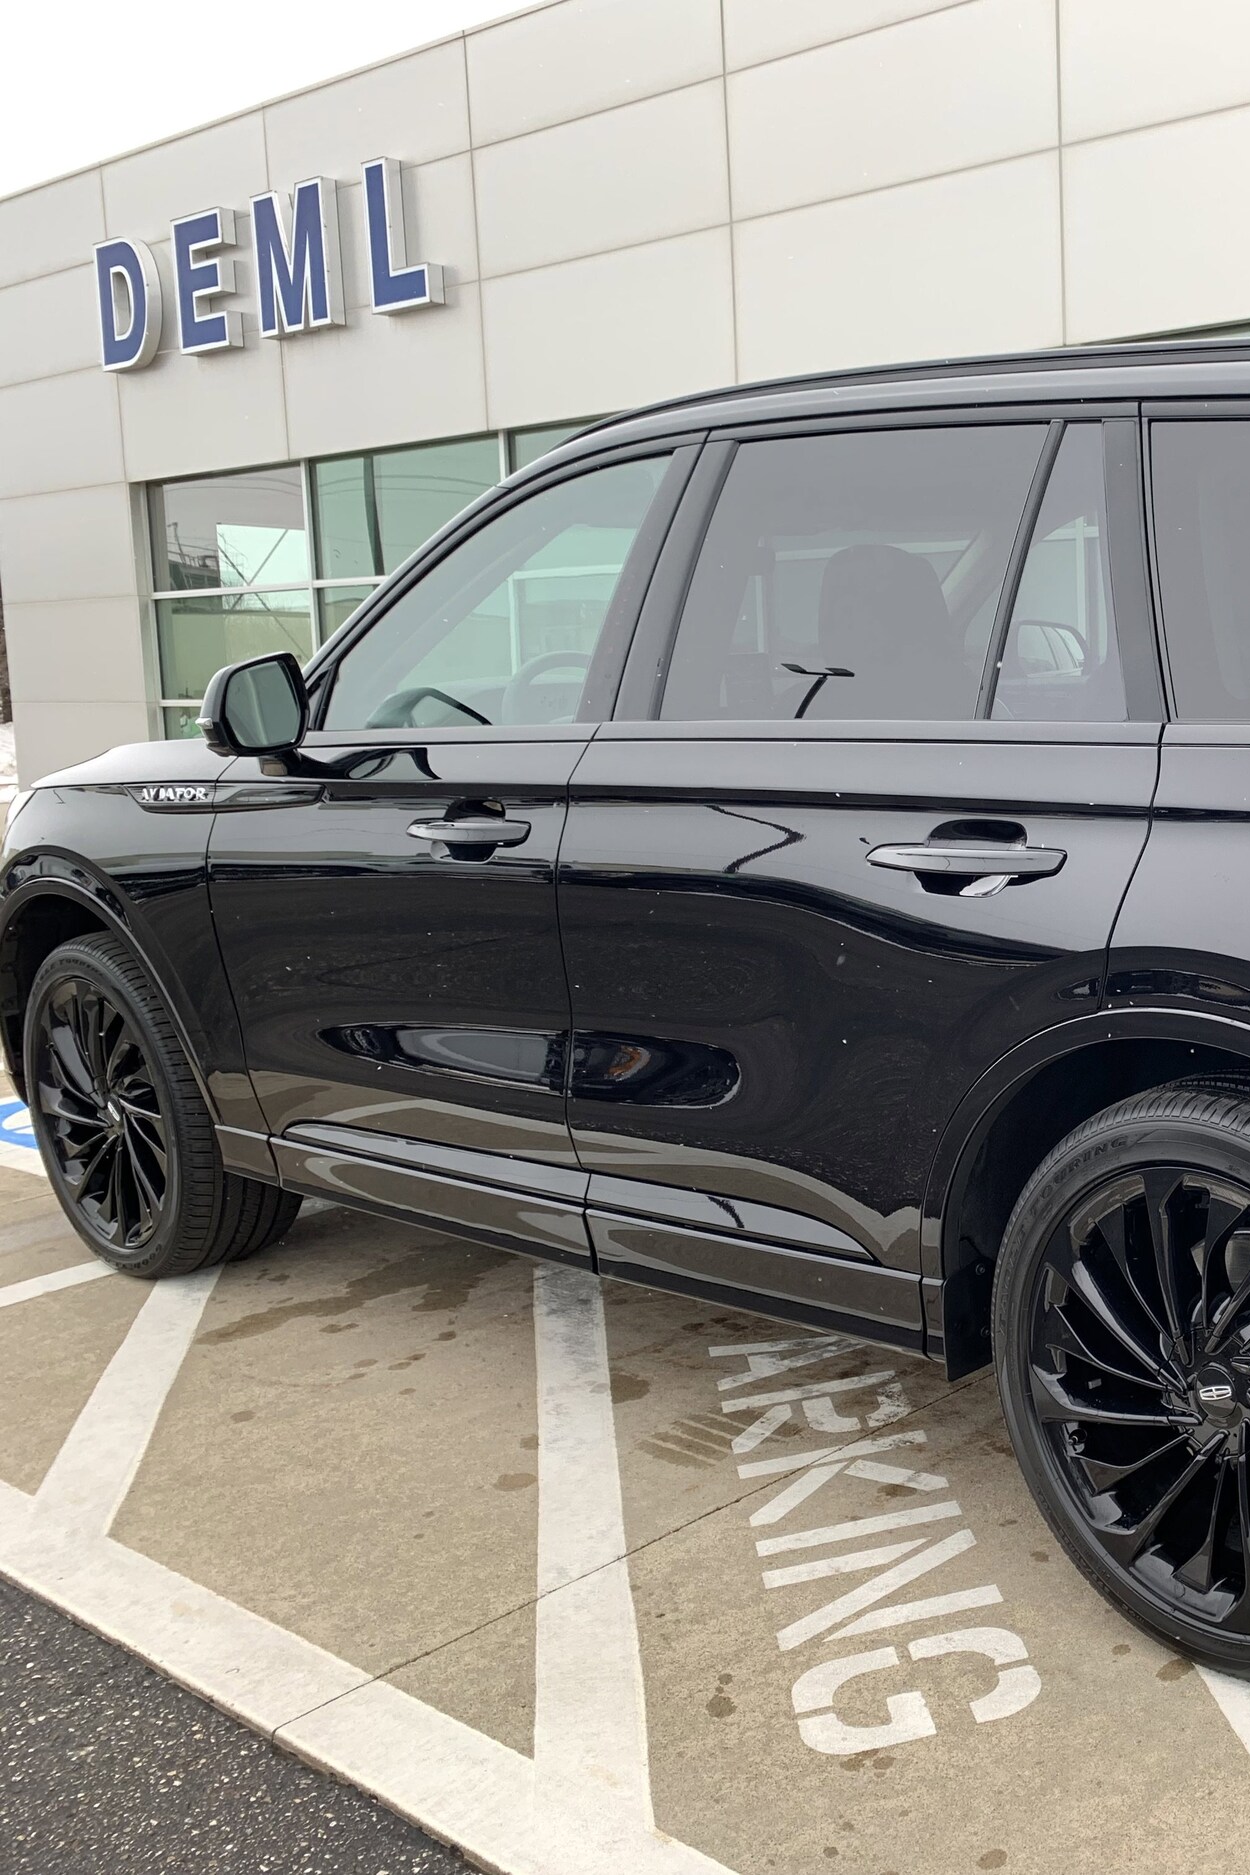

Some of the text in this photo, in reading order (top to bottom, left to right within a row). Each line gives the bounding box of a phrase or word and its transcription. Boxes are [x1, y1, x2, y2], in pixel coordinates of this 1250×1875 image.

[93, 156, 446, 373] DEML
[141, 786, 208, 801] AVIATOR
[708, 1335, 1042, 1756] ARKING
